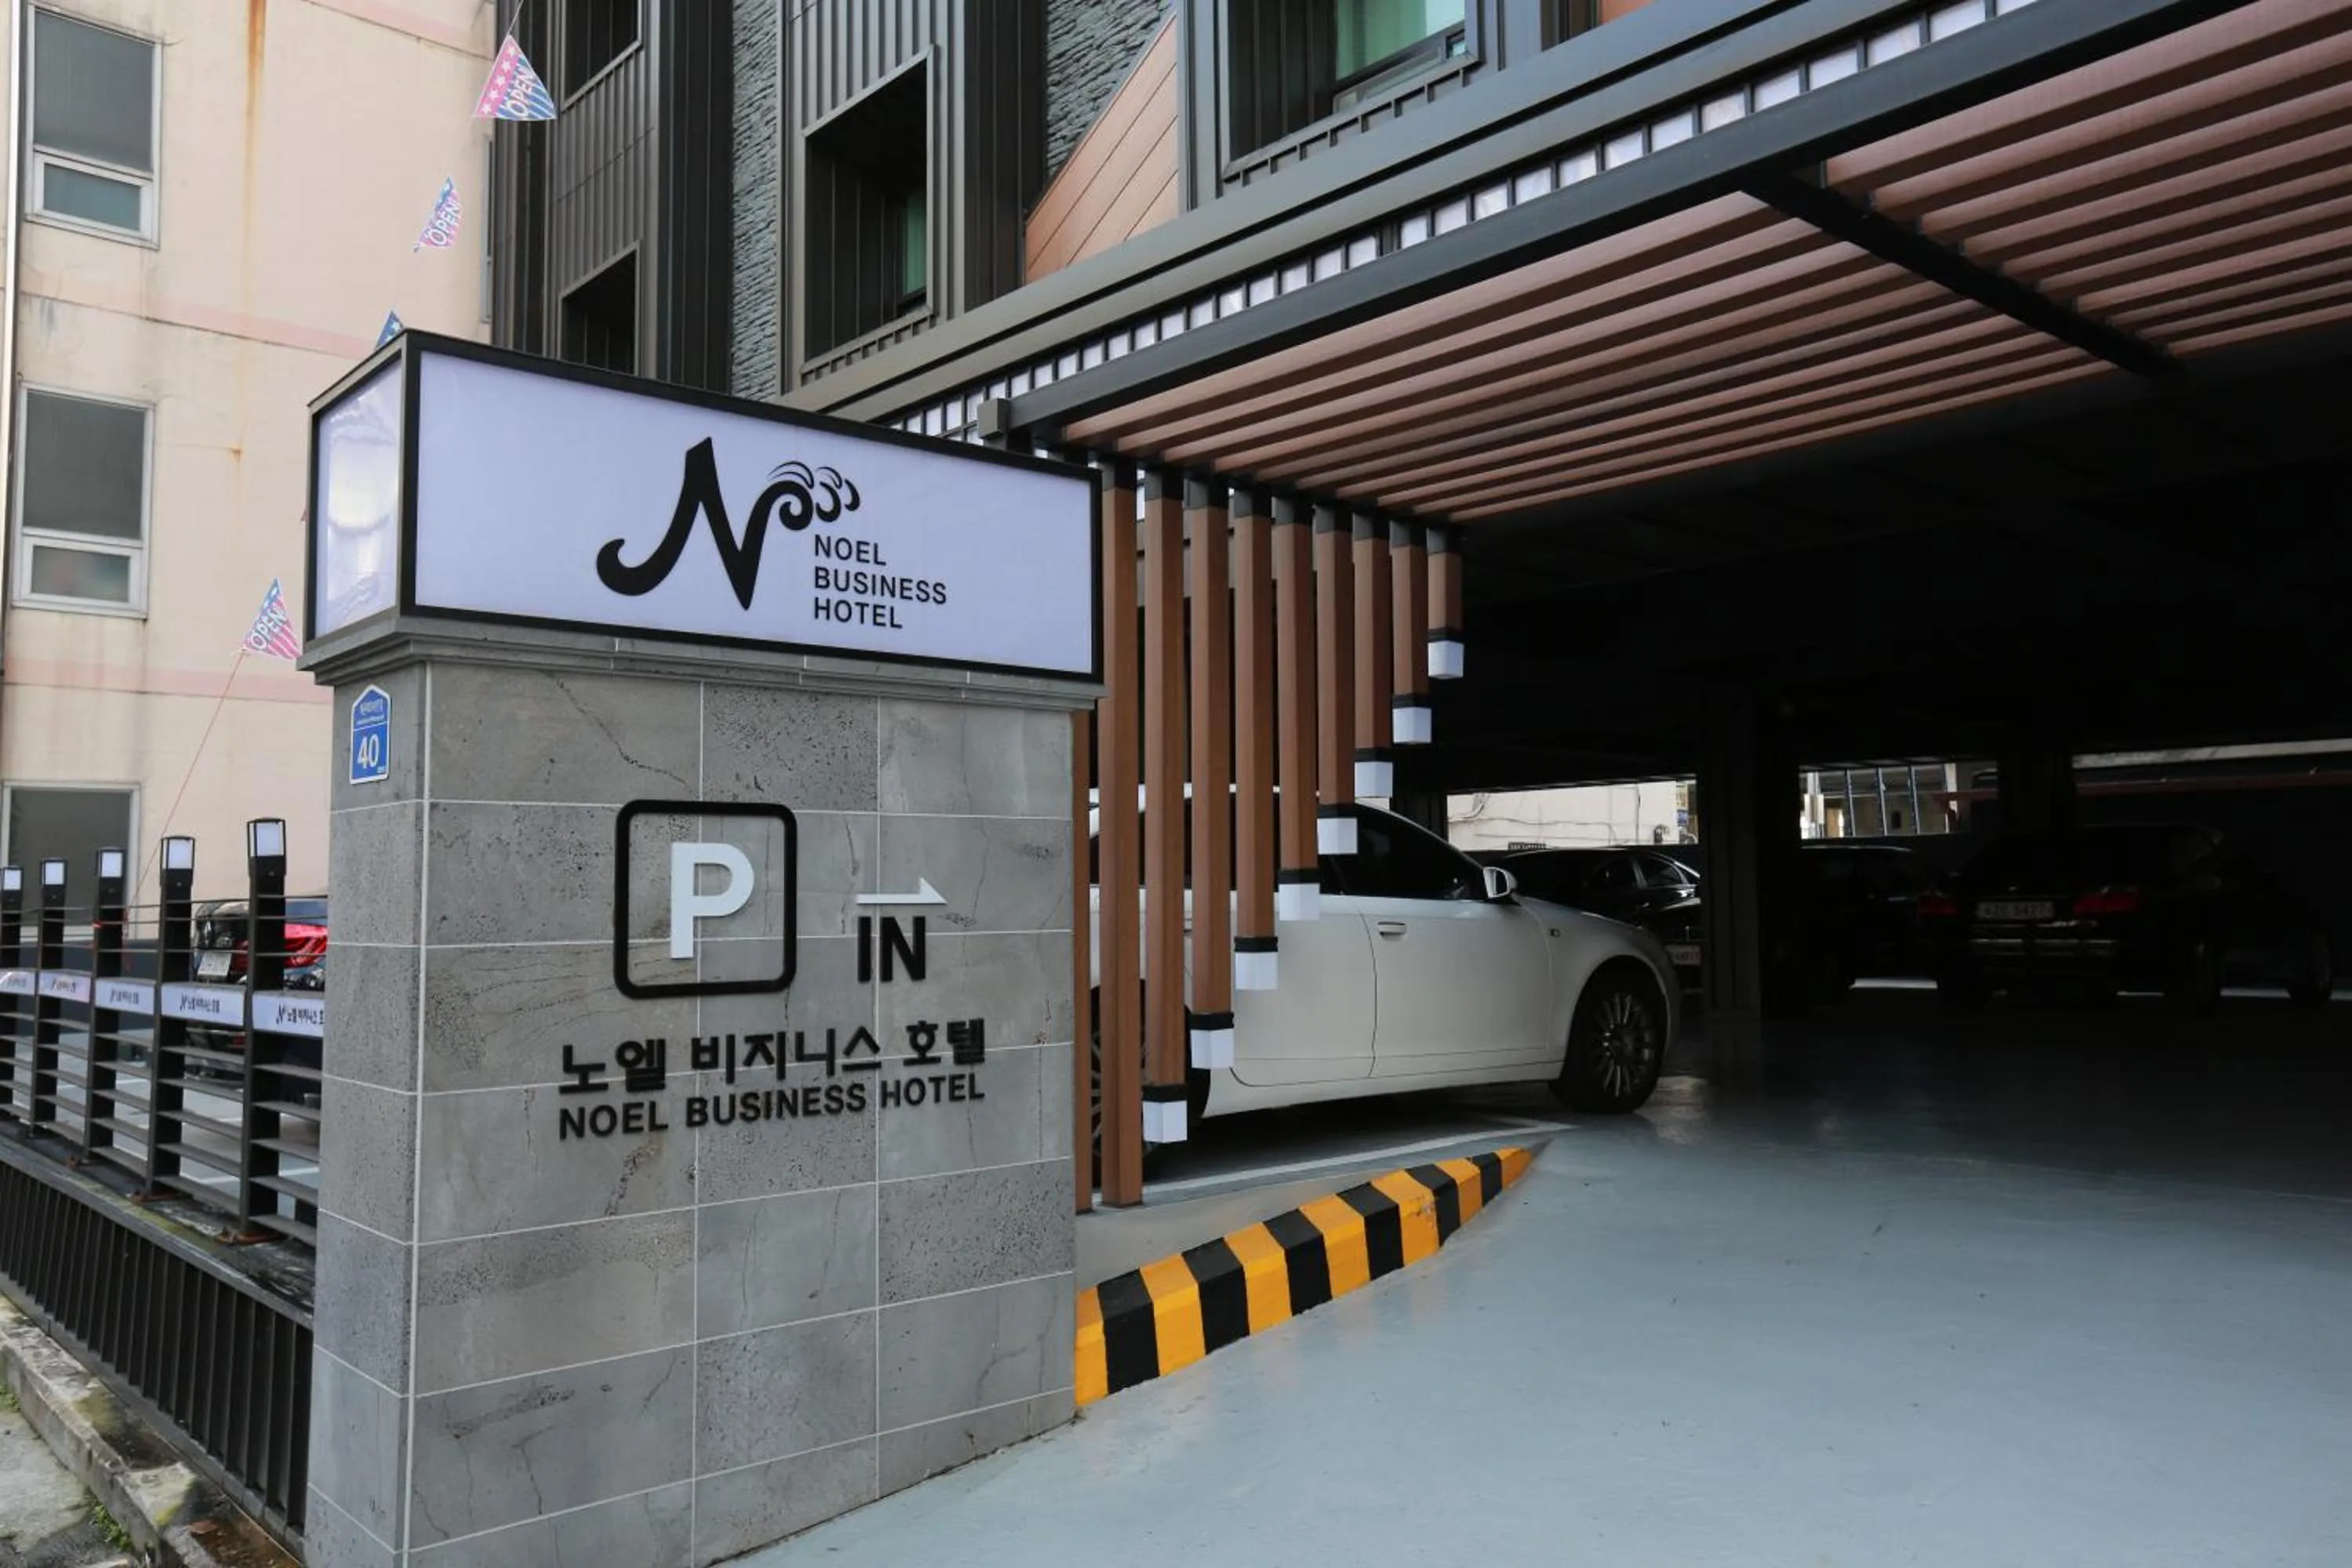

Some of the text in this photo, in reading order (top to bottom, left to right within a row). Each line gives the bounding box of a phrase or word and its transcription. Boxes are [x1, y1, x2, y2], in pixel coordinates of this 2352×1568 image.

[814, 533, 887, 567] NOEL
[814, 564, 947, 606] BUSINESS
[250, 607, 288, 650] OPEN
[814, 596, 903, 630] HOTEL
[357, 733, 379, 769] 40
[670, 841, 755, 959] P
[857, 915, 927, 984] IN
[557, 1018, 986, 1095] 노엘 비지니스 호텔
[558, 1072, 986, 1142] NOEL BUSINESS HOTEL
